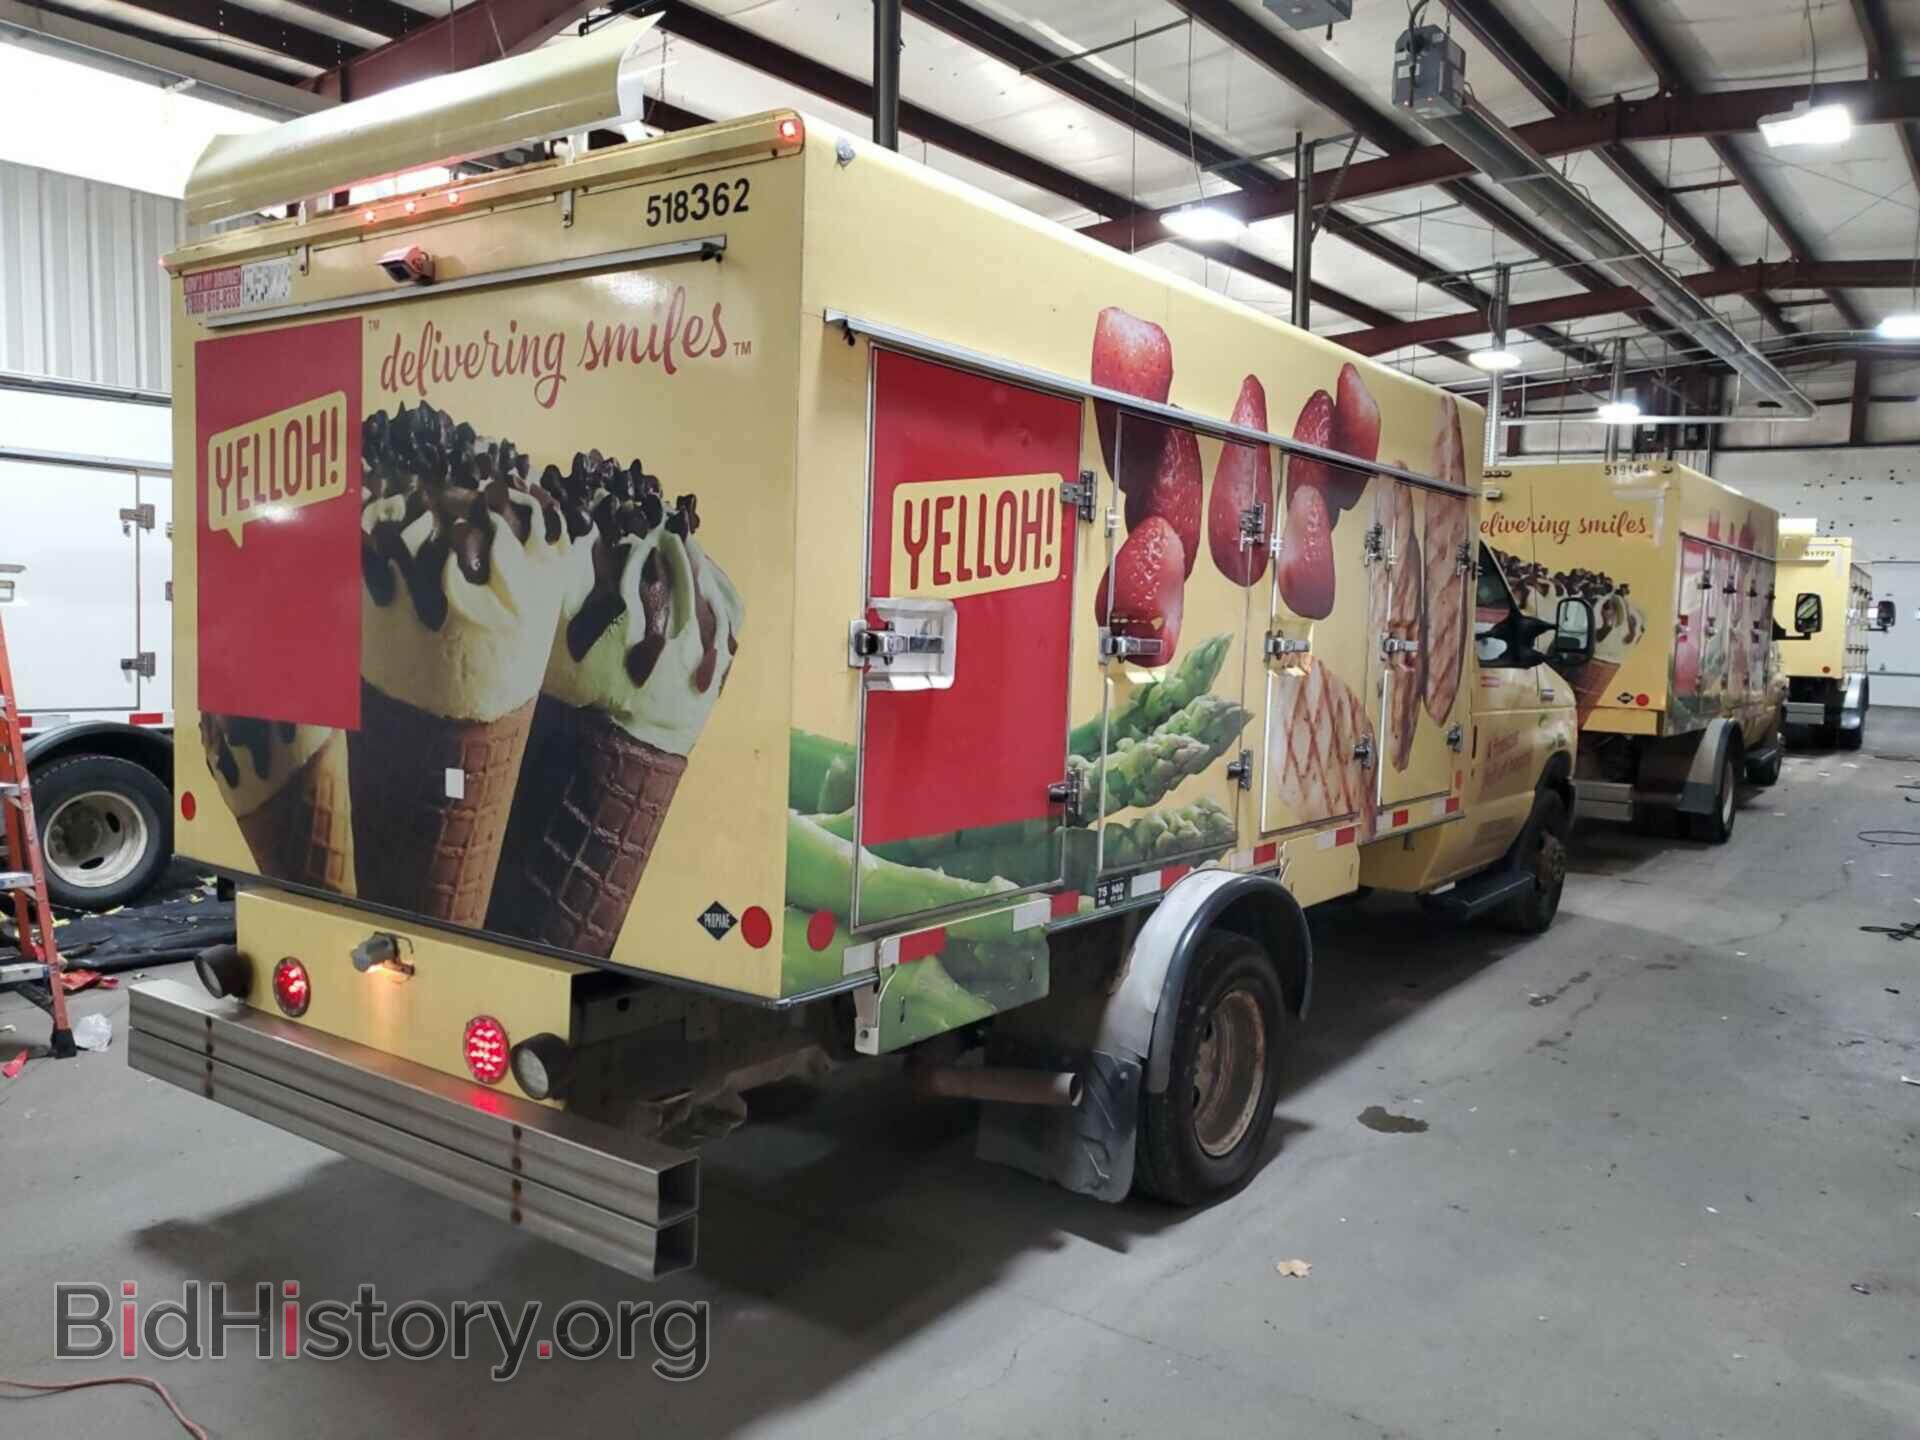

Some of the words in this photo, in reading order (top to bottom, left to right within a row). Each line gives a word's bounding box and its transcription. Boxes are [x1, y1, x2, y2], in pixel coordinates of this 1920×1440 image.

[646, 178, 750, 227] 518362
[380, 319, 567, 408] delivering
[577, 285, 728, 374] smiles
[215, 406, 338, 516] YELLOH!
[904, 487, 1055, 590] YELLOH!
[1578, 510, 1647, 537] smiles
[704, 912, 729, 928] PROPANE
